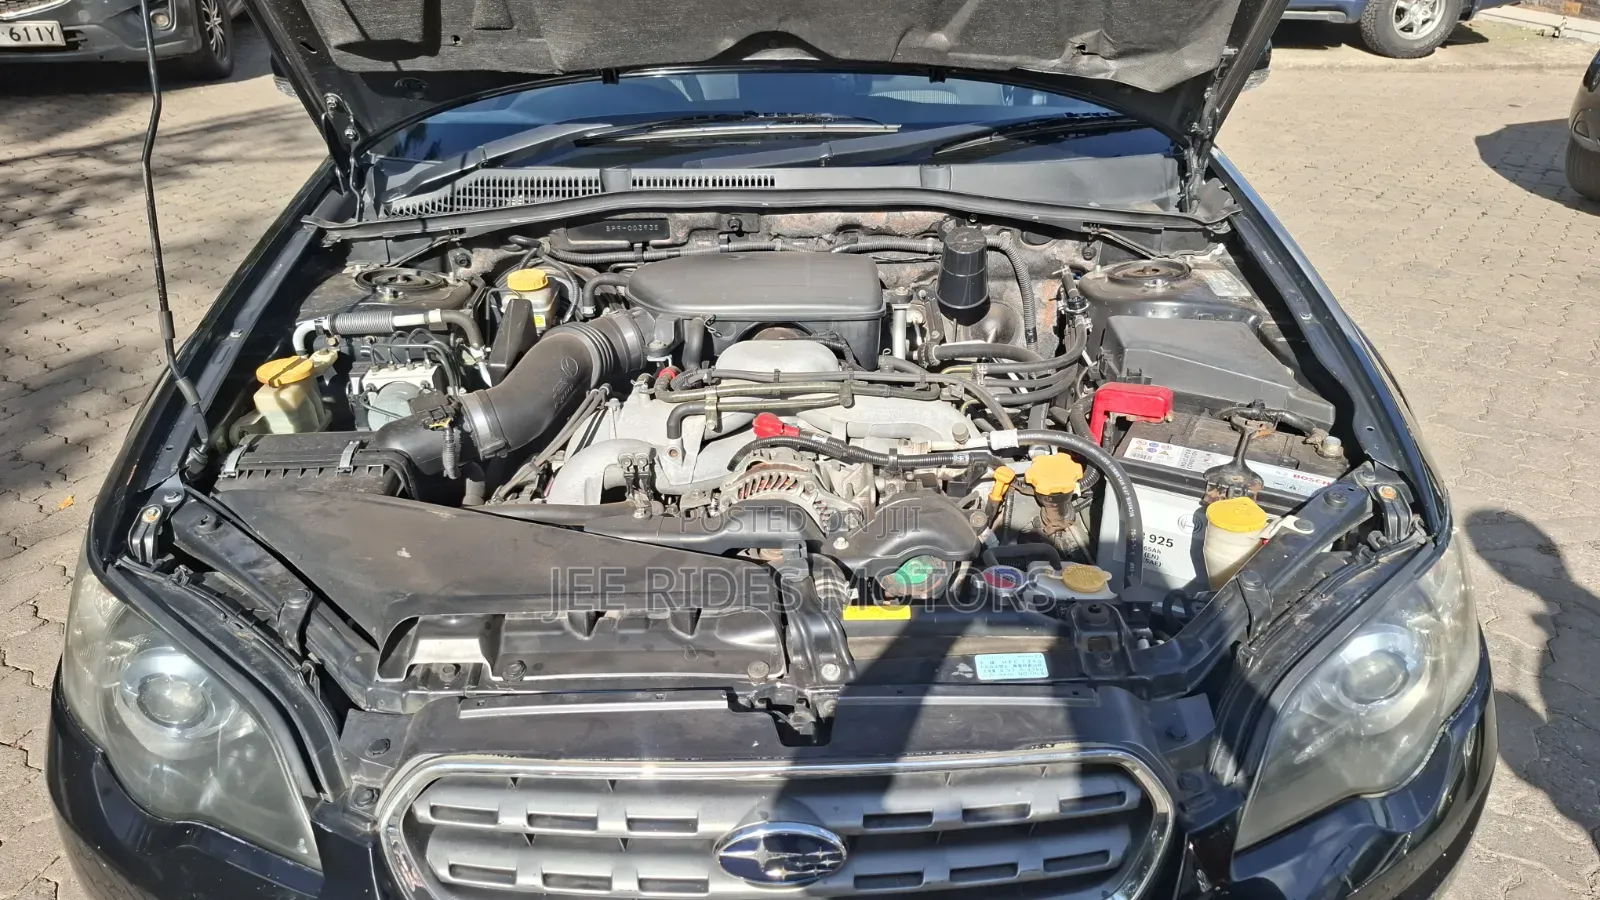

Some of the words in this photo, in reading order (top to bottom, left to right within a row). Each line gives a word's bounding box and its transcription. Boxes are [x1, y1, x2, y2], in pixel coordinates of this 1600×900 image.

[9, 26, 55, 42] 611Y
[1293, 473, 1331, 487] BOSCH
[1148, 533, 1174, 548] 925
